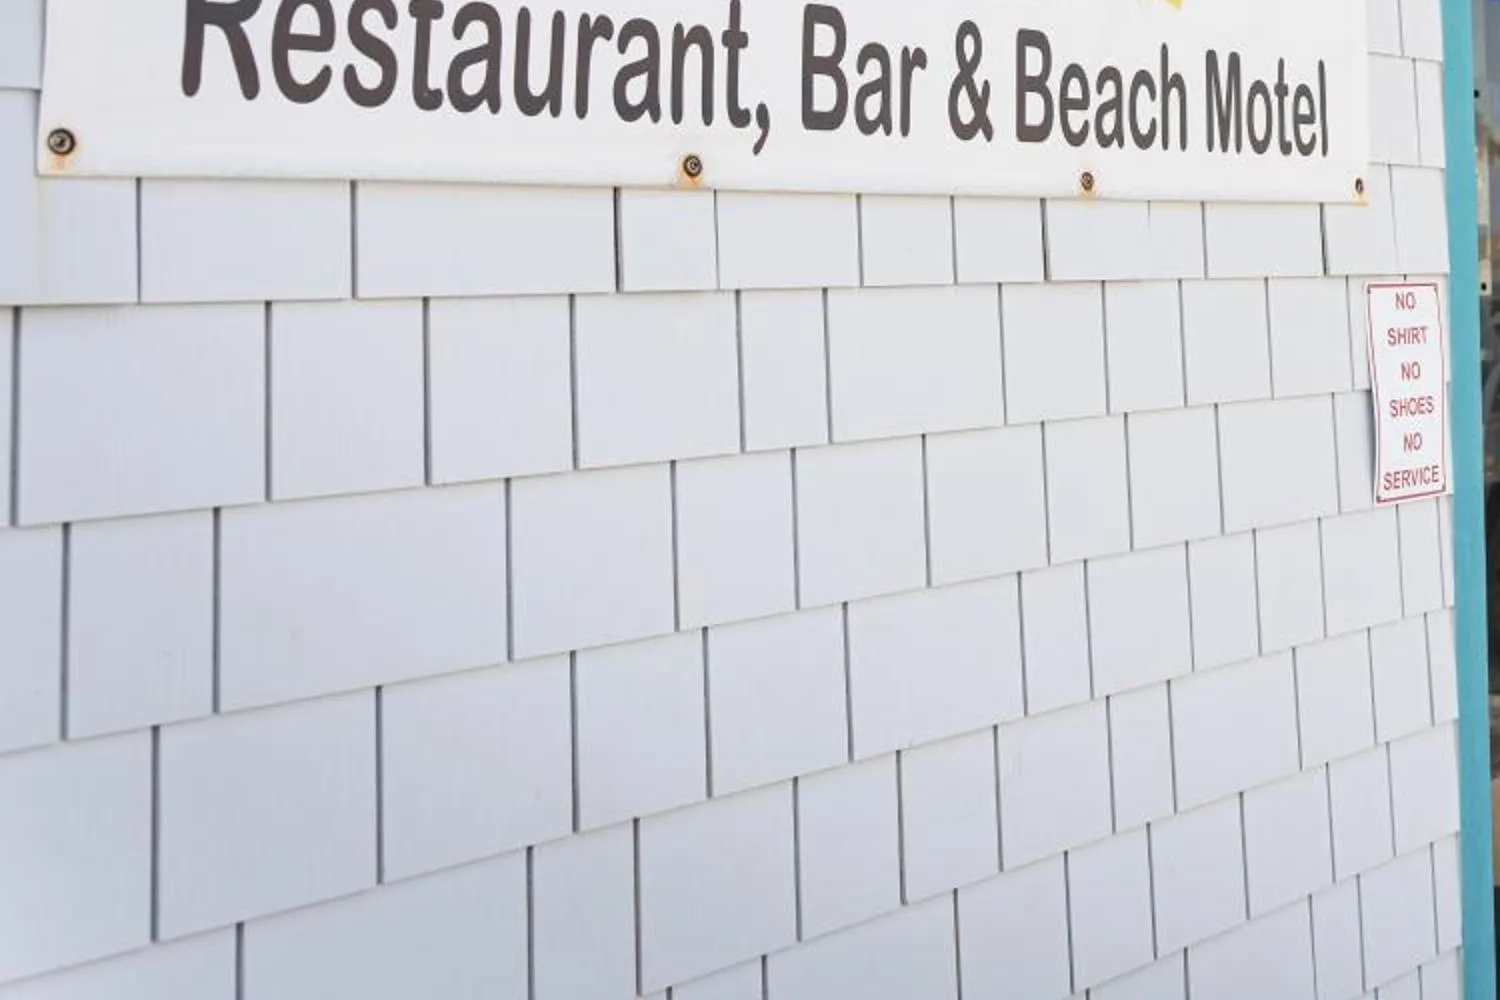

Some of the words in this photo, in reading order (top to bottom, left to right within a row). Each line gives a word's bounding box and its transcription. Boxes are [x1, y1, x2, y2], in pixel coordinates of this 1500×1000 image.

[801, 3, 927, 137] Bar
[948, 20, 993, 142] &
[1016, 29, 1187, 151] Beach
[1205, 49, 1328, 156] Motel
[1395, 292, 1416, 310] NO
[1387, 326, 1428, 346] SHIRT
[1401, 362, 1421, 380] NO
[1389, 396, 1434, 418] SHOES
[1403, 432, 1422, 452] NO
[1383, 465, 1439, 491] SERVICE
